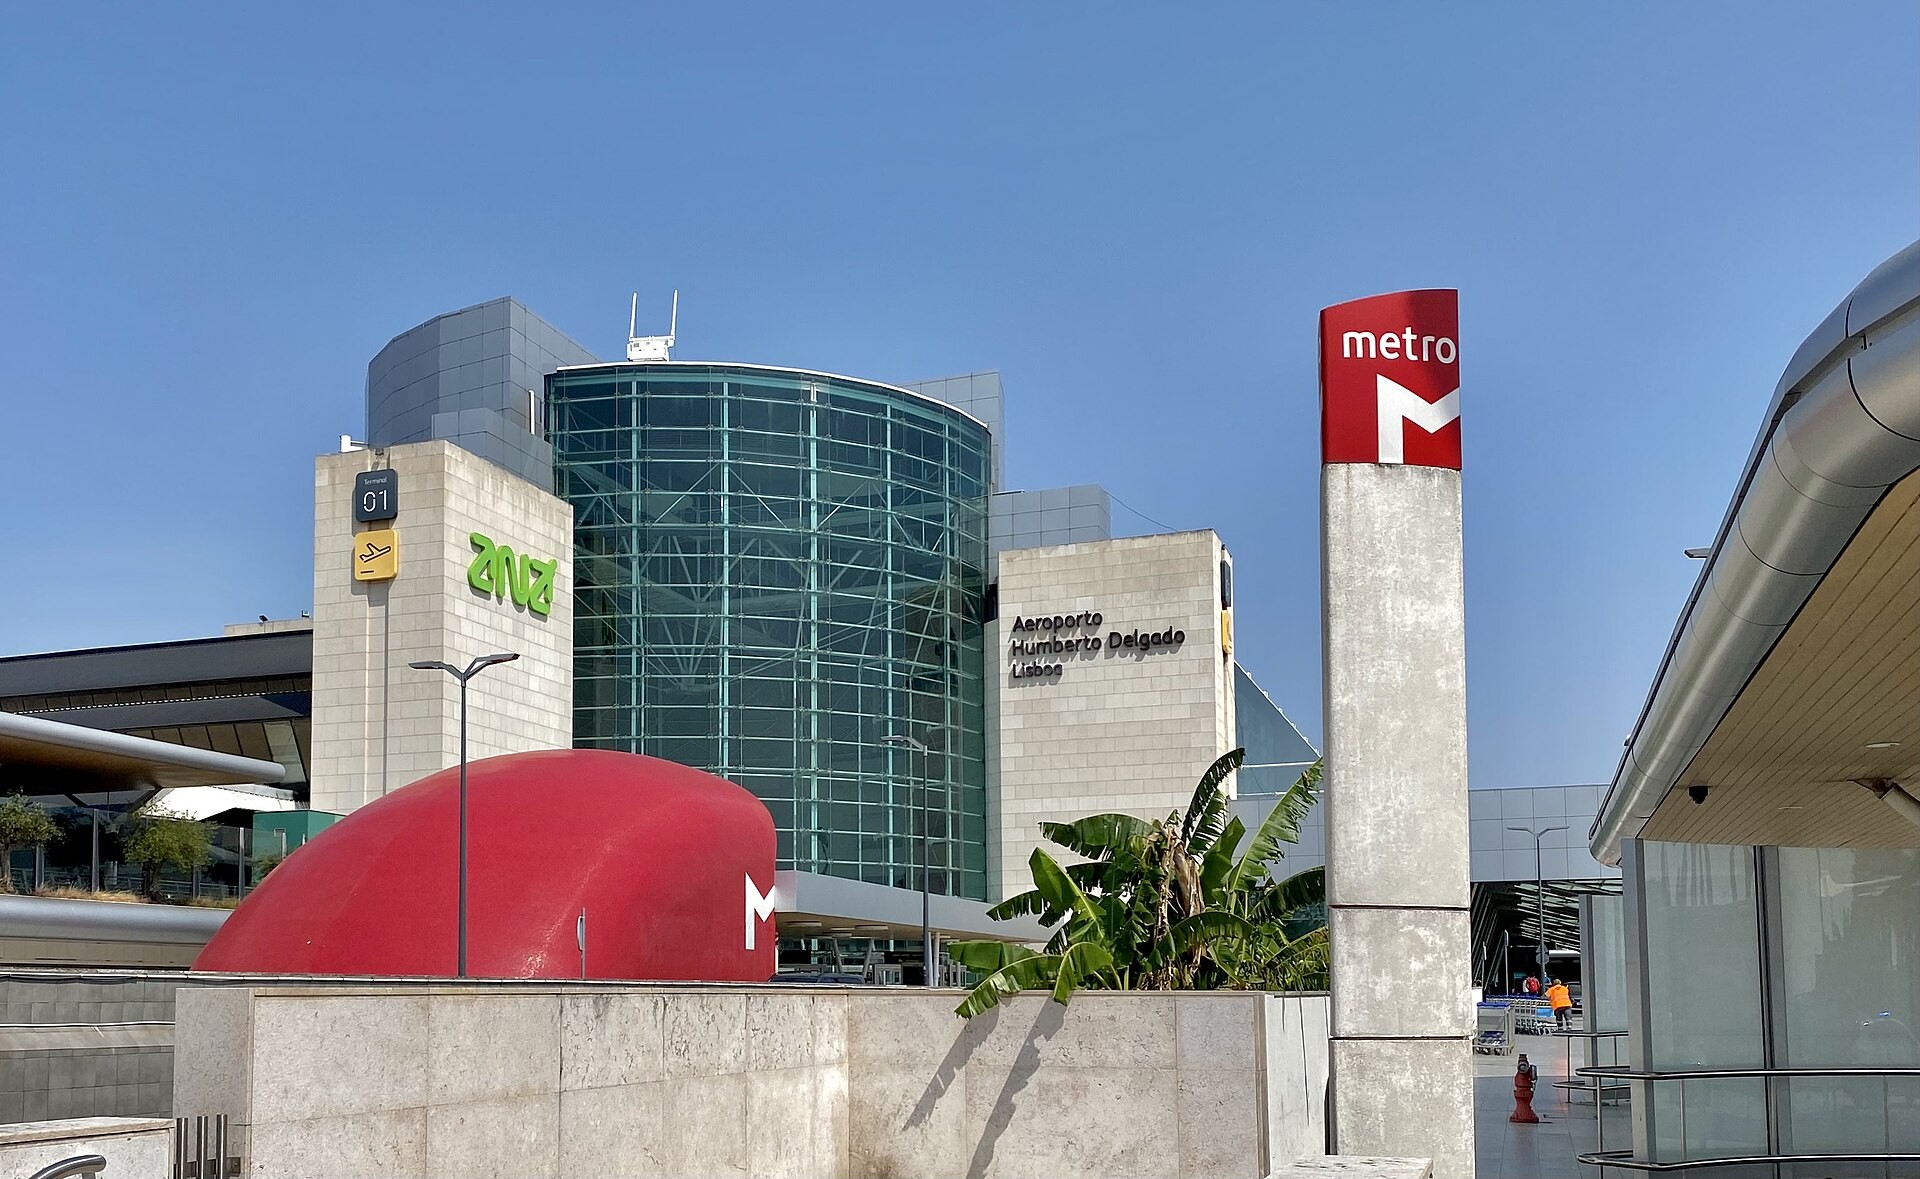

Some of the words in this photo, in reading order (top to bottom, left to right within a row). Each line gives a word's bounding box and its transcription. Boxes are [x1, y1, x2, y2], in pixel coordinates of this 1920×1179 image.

[1342, 326, 1457, 364] metro
[363, 490, 387, 512] 01
[1012, 610, 1103, 633] Aeroporto
[1012, 635, 1102, 656] Humberto
[1109, 626, 1186, 650] Delgado
[1012, 663, 1063, 679] Lisboa
